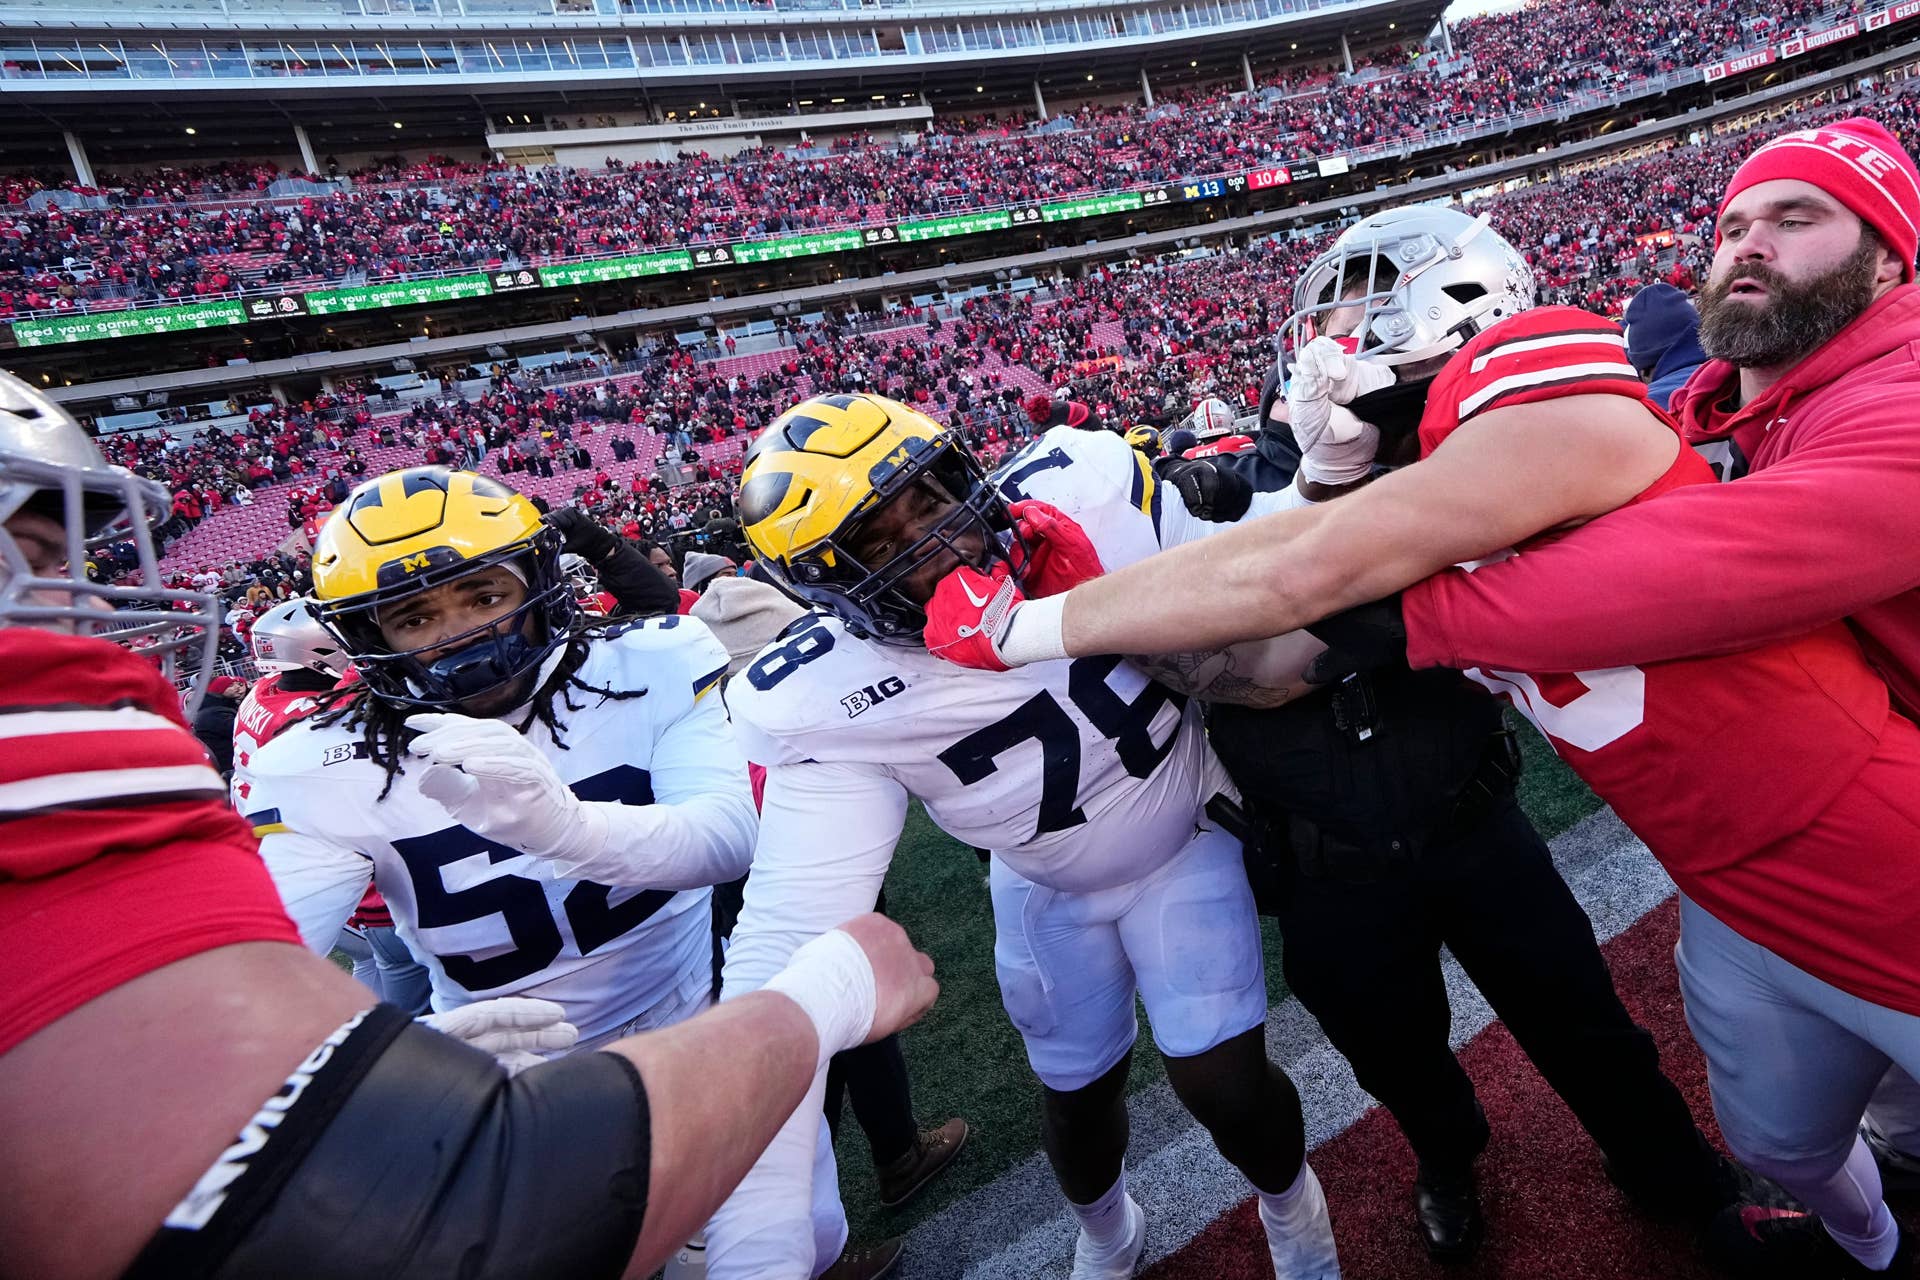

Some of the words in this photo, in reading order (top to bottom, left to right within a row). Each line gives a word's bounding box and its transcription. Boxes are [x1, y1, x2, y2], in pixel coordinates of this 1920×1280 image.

[1870, 13, 1886, 28] 27
[1895, 0, 1920, 19] GEO
[1785, 43, 1800, 56] 22
[1806, 23, 1856, 49] HORVATH
[1708, 66, 1722, 80] 10
[1730, 52, 1768, 72] SMITH
[723, 121, 748, 130] Family
[1202, 181, 1219, 195] 13
[1228, 176, 1244, 187] 0:00
[1256, 172, 1273, 186] 10
[736, 248, 754, 257] feed
[757, 246, 776, 256] your
[778, 242, 802, 253] game
[805, 239, 821, 250] day
[823, 236, 860, 247] traditions
[542, 270, 565, 281] feed
[568, 268, 590, 279] your
[593, 264, 621, 276] game
[624, 260, 643, 272] day
[646, 256, 689, 269] traditions
[309, 296, 336, 308] feed
[340, 294, 367, 306] your
[371, 290, 405, 303] game
[409, 285, 432, 298] day
[435, 281, 487, 294] traditions
[18, 327, 53, 339] feed
[58, 324, 91, 336] your
[97, 318, 139, 333] game
[144, 312, 171, 326] day
[177, 307, 241, 322] traditions
[887, 447, 910, 468] M
[400, 552, 431, 573] M
[937, 654, 1190, 834] 78
[390, 764, 680, 992] 52
